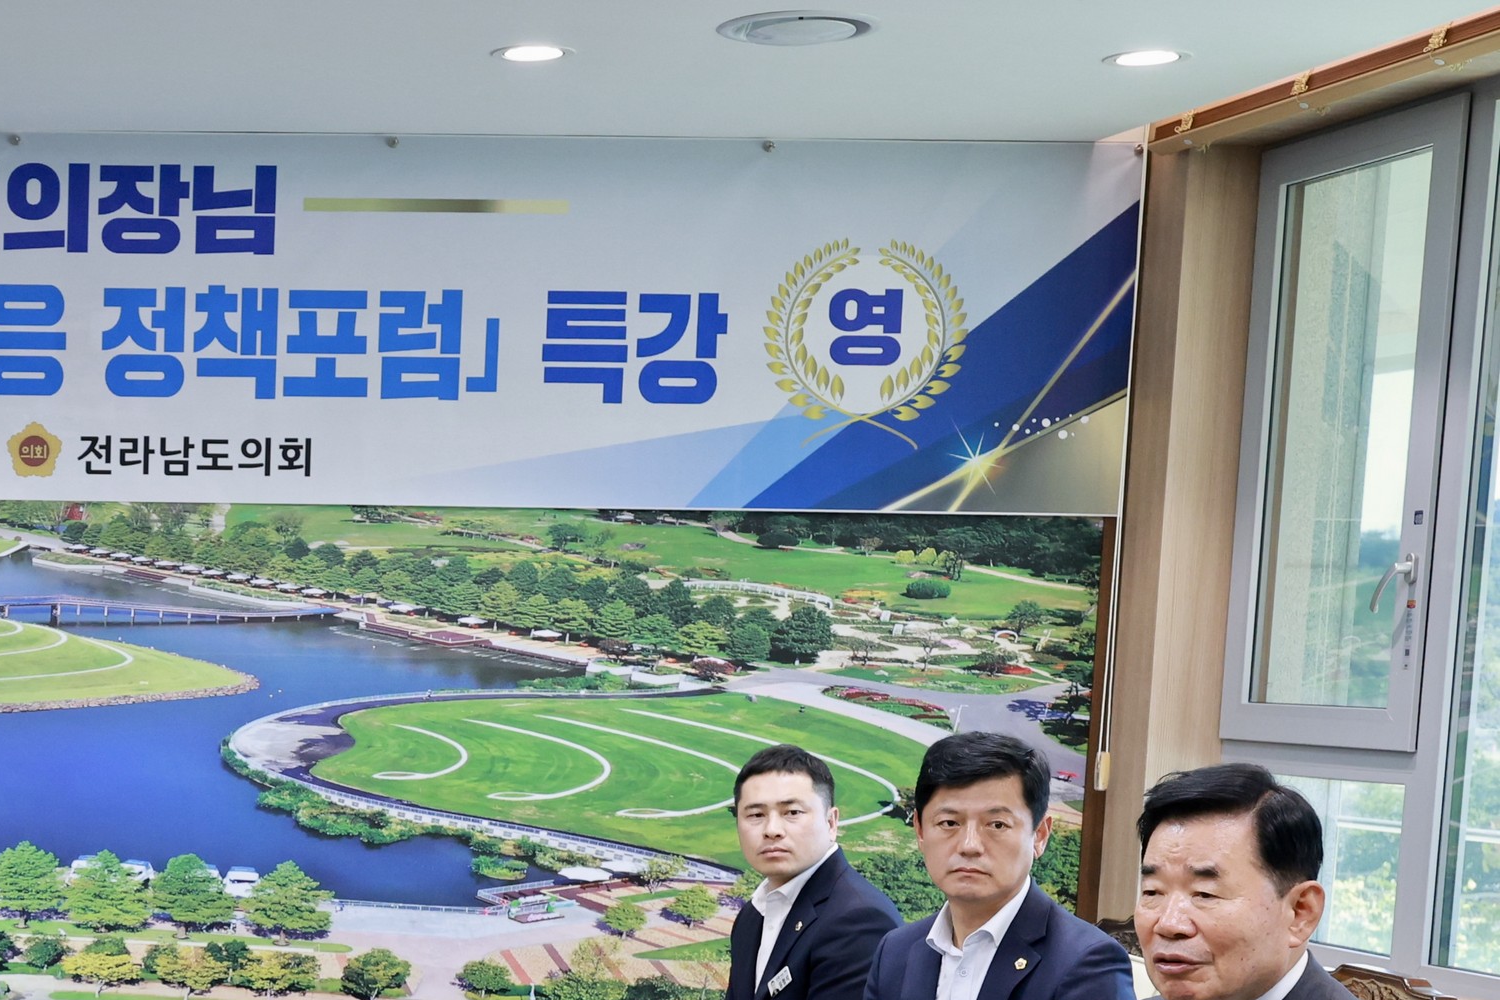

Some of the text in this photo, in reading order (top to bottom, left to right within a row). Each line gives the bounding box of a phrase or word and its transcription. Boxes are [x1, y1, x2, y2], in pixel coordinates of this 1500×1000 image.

[102, 285, 500, 401] 정책포럼」
[542, 290, 728, 404] 특강
[828, 288, 904, 366] 영
[20, 445, 47, 459] 의회
[77, 435, 312, 477] 전라남도의회
